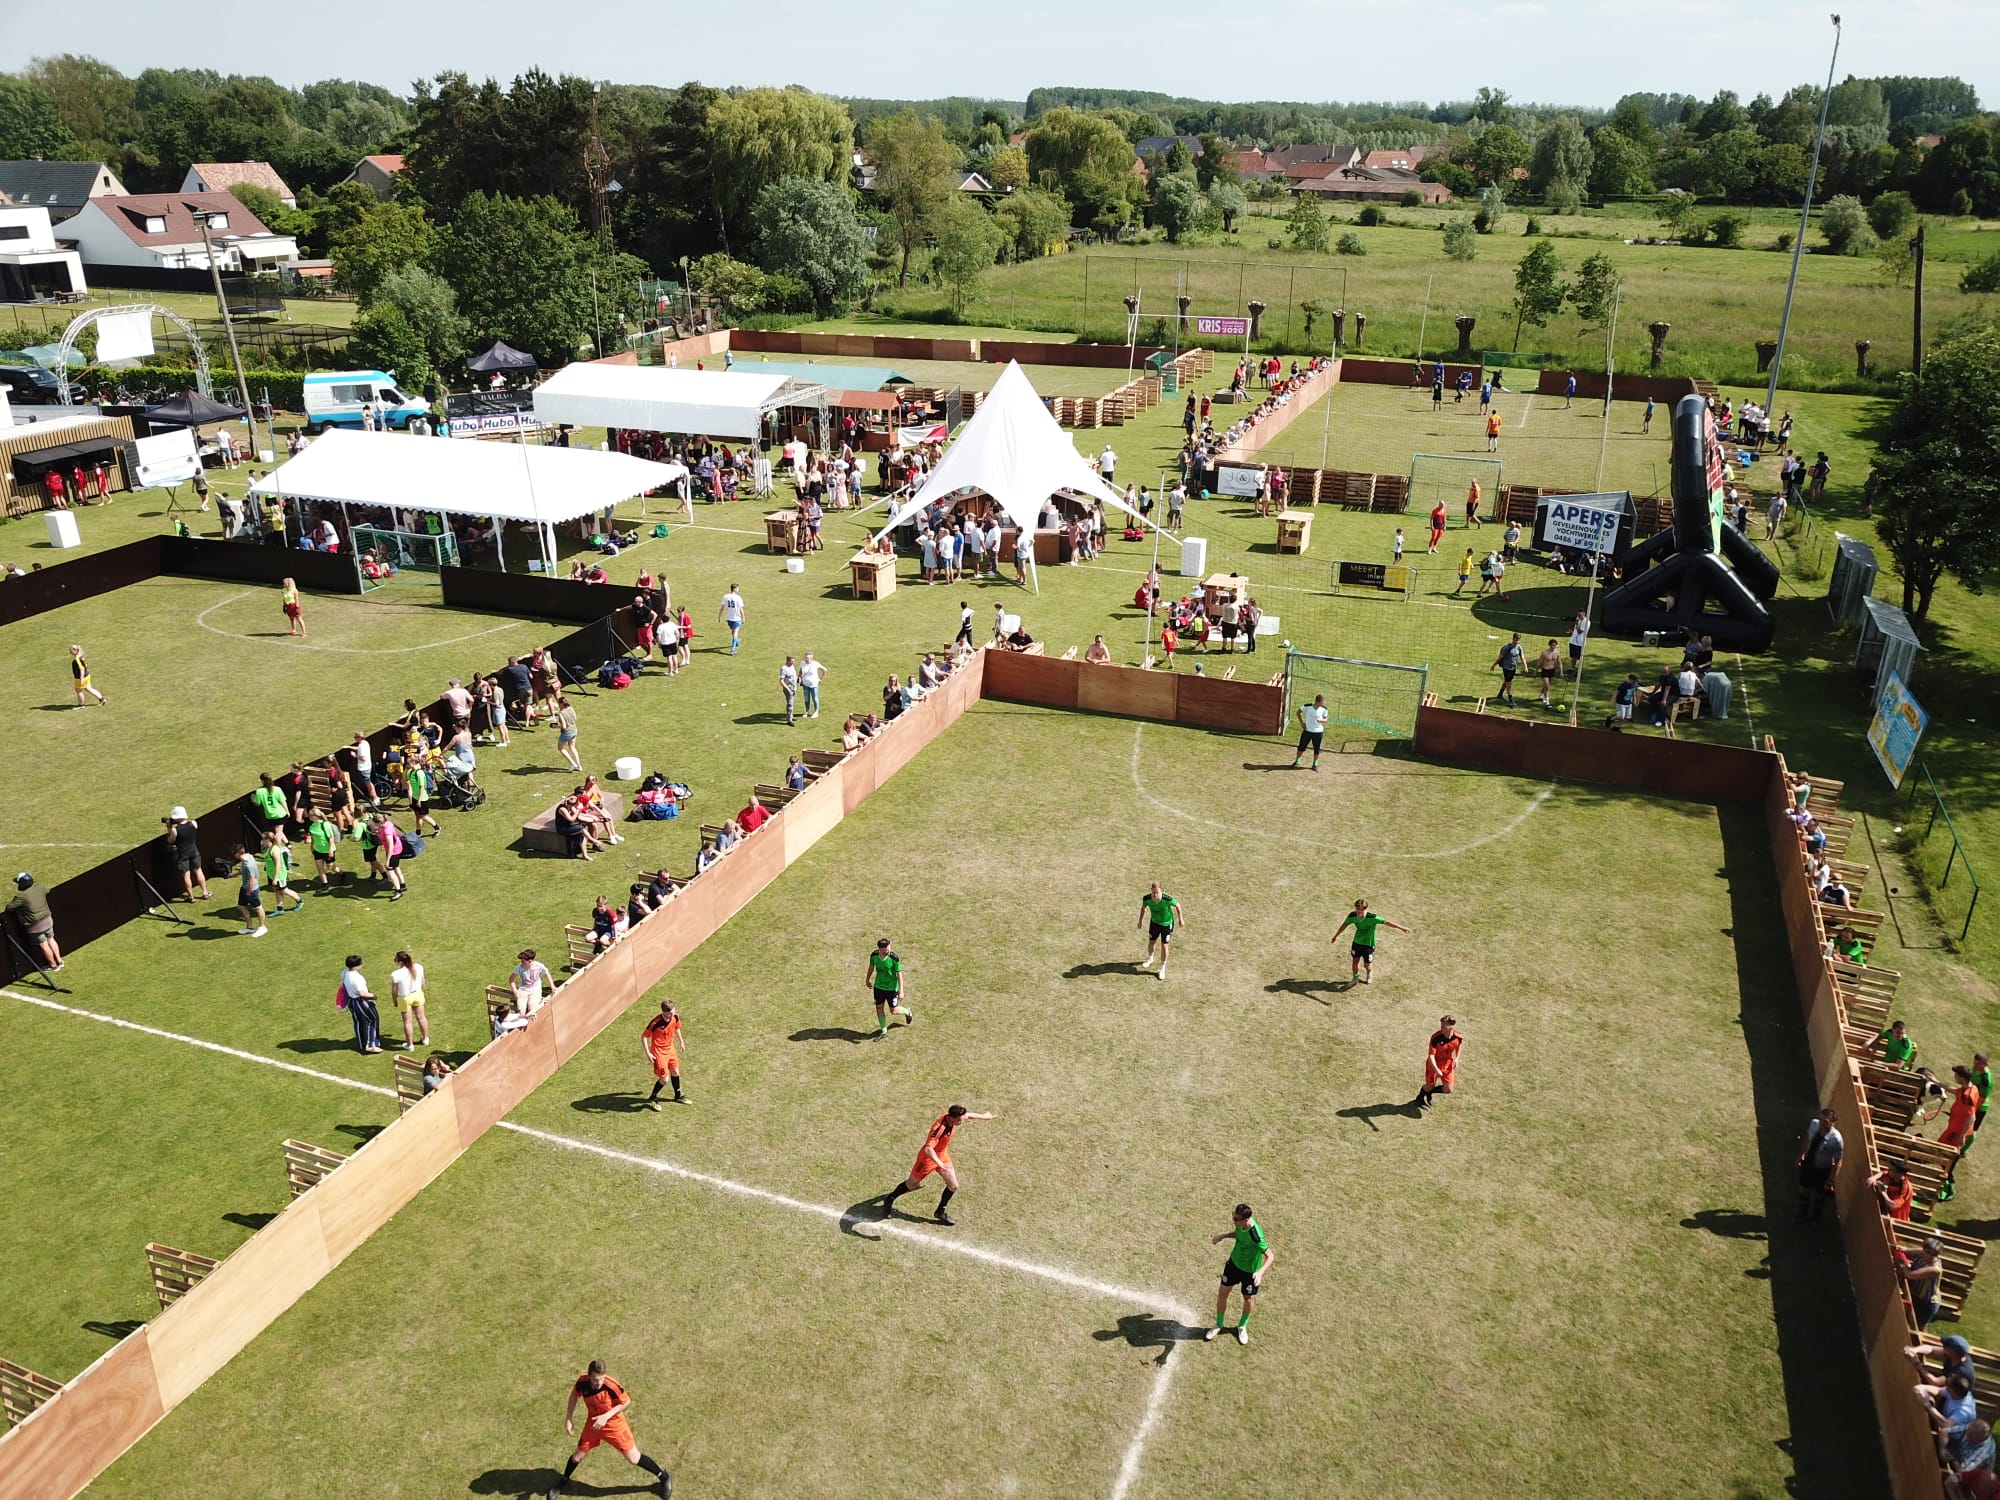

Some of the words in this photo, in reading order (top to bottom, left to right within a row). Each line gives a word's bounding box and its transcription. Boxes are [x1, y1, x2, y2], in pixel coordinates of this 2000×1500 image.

[1198, 319, 1221, 333] KRIS
[483, 418, 514, 428] Hubo
[1551, 503, 1616, 530] APERS
[1552, 520, 1610, 537] GEVELRENOVAES
[727, 599, 736, 609] 15
[267, 796, 274, 806] 5
[1246, 1284, 1253, 1294] 4
